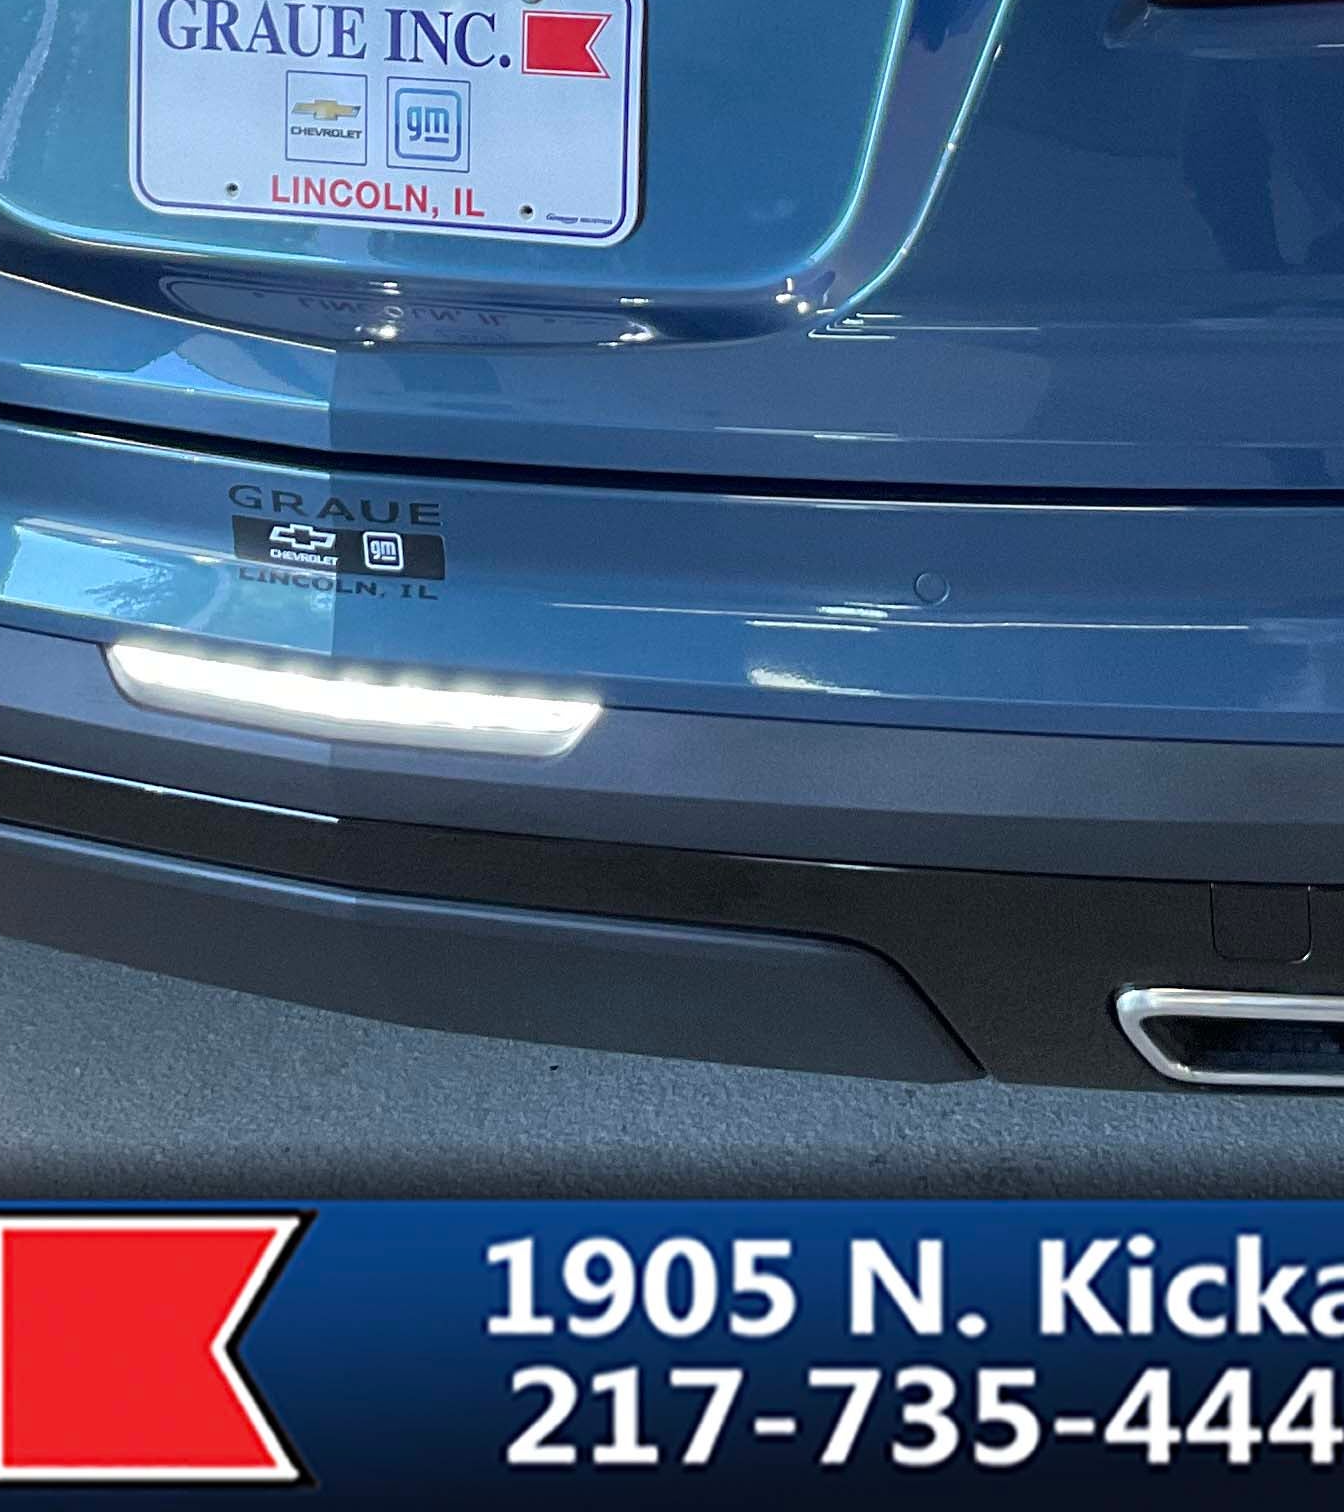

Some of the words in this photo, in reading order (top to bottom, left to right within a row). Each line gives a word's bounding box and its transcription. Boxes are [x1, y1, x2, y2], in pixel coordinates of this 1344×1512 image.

[384, 8, 511, 69] INC.
[290, 125, 363, 140] CHEVROLET
[407, 105, 451, 143] gm
[272, 174, 439, 220] LINCOLN,
[454, 187, 486, 218] IL
[228, 484, 443, 527] GRAUE
[270, 548, 339, 566] CHEVROLET
[370, 540, 397, 561] gm
[239, 566, 385, 598] LINCOLN,
[401, 583, 439, 600] IL
